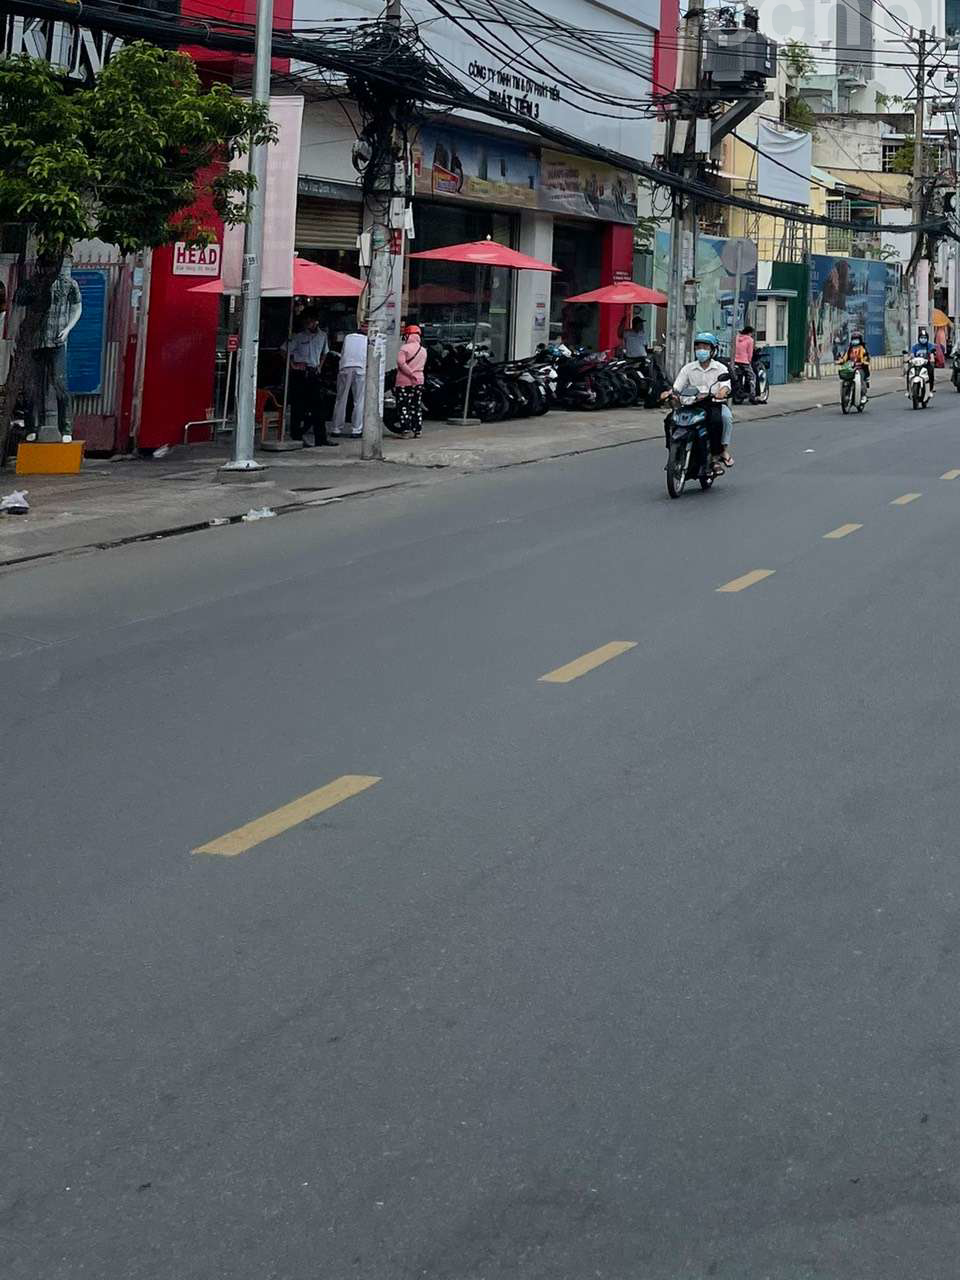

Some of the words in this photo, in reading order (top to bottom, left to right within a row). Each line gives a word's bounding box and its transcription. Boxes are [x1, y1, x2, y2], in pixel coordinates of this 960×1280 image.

[10, 13, 126, 81] KIN
[534, 102, 540, 119] 3
[176, 246, 217, 265] HEAD
